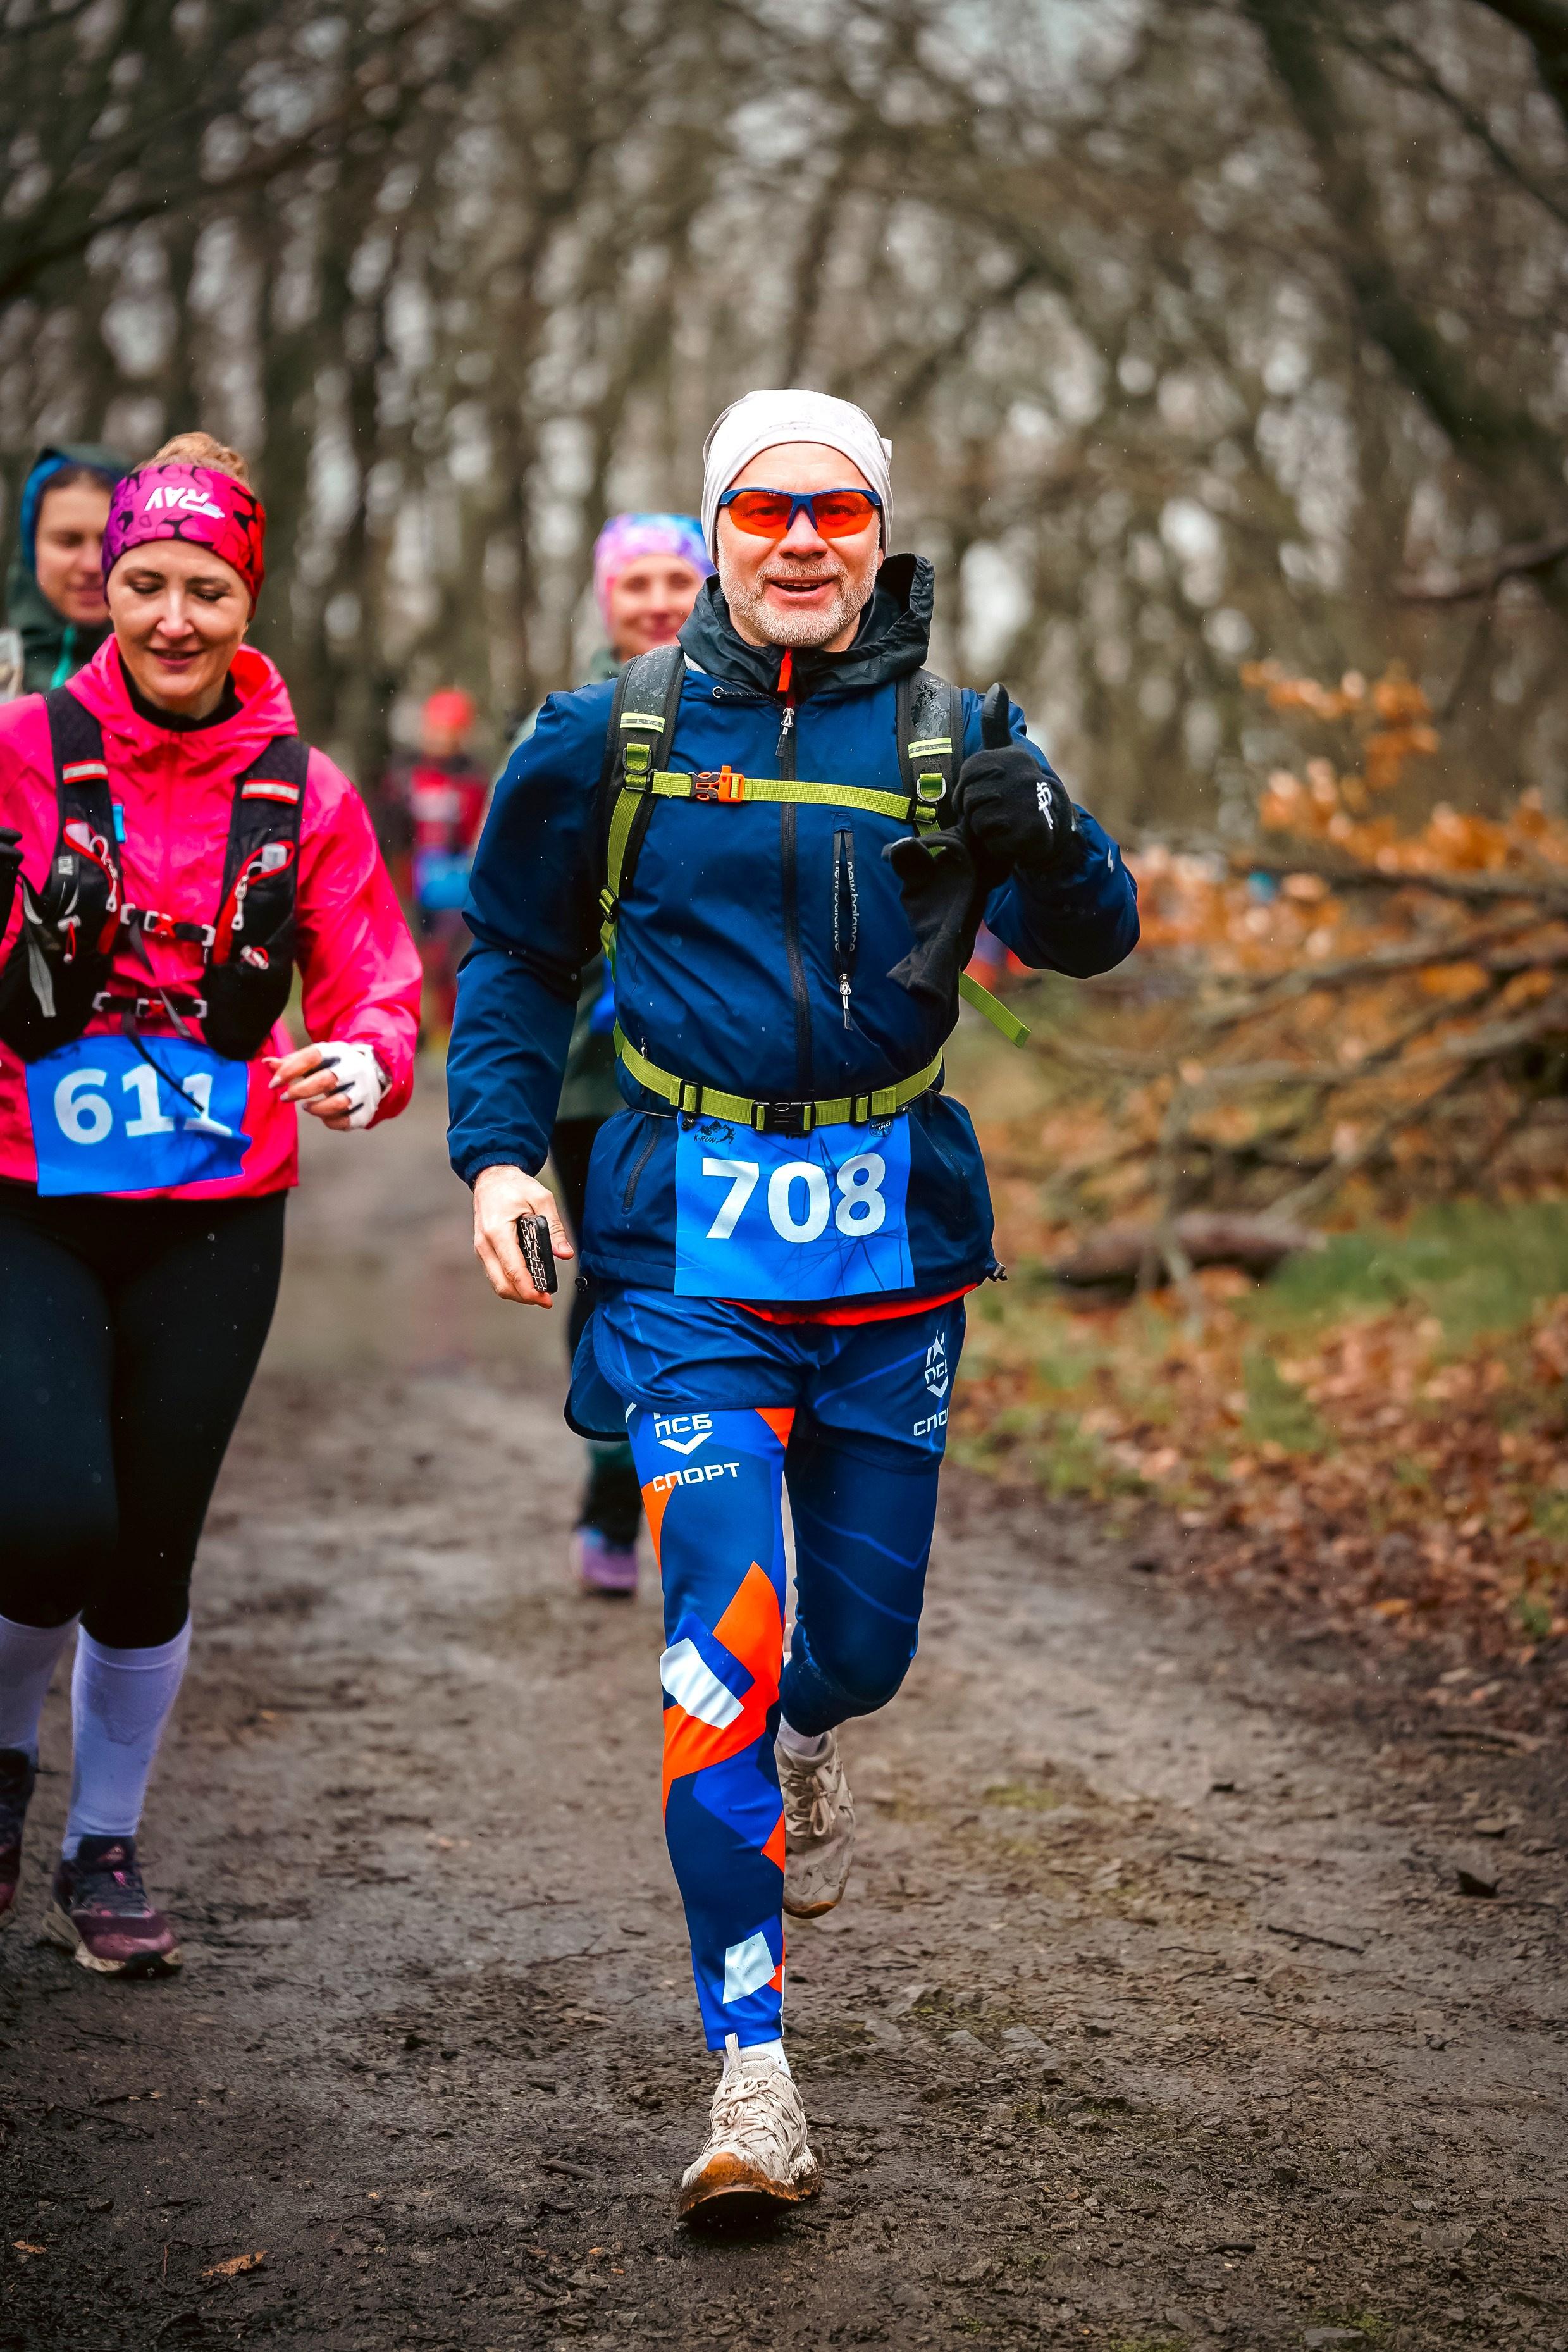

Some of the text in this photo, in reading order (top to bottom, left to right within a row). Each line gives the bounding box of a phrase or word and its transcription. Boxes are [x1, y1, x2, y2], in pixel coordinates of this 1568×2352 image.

[54, 1063, 233, 1145] 611
[693, 1134, 717, 1144] K-RUN
[702, 1153, 886, 1244] 708
[925, 1358, 948, 1385] ПС
[655, 1413, 713, 1439] ПСБ
[913, 1406, 949, 1437] СПО
[652, 1461, 740, 1492] СПОРТ
